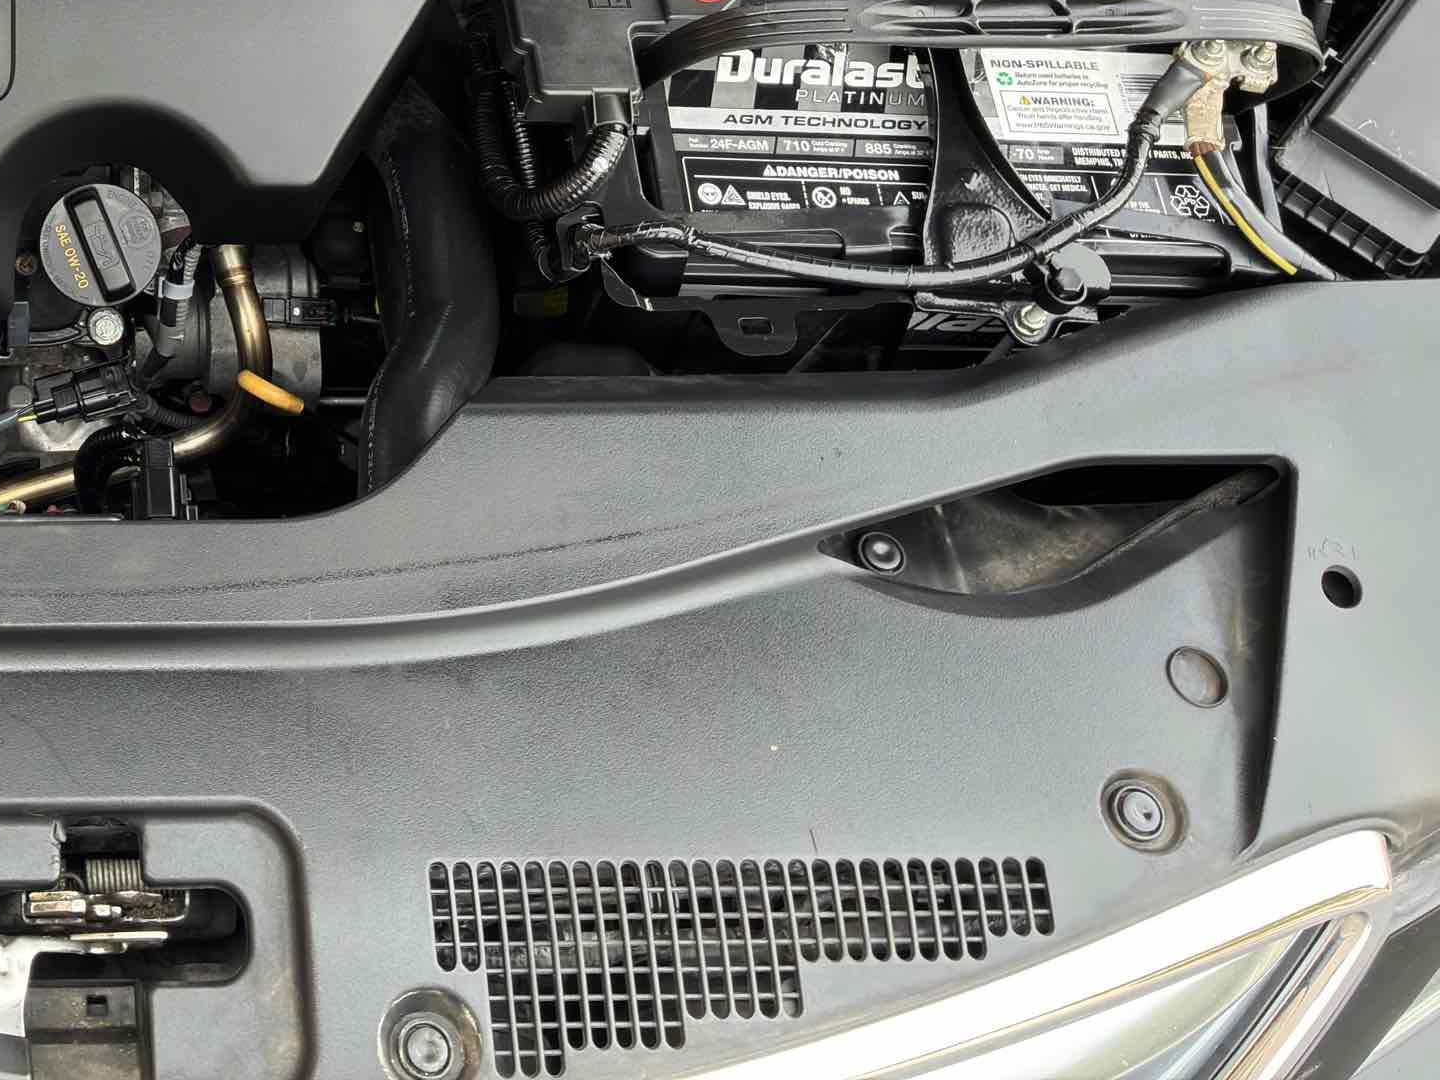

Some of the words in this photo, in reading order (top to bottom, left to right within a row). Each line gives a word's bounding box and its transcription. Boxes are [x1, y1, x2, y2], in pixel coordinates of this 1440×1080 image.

[717, 49, 924, 88] Duralast
[990, 59, 1100, 71] NON-SPILLABLE
[795, 89, 926, 106] PLATINUM
[1031, 96, 1095, 107] WARNING:
[723, 114, 773, 126] AGM
[781, 116, 927, 130] TECHNOLOGY
[710, 138, 769, 151] 24F-AGM
[783, 140, 810, 152] 710
[864, 142, 892, 154] 885
[1072, 147, 1120, 157] DISTRIBUTED
[776, 165, 900, 181] DANGER/POISON
[56, 224, 72, 247] SAE
[65, 248, 89, 288] 0W-20
